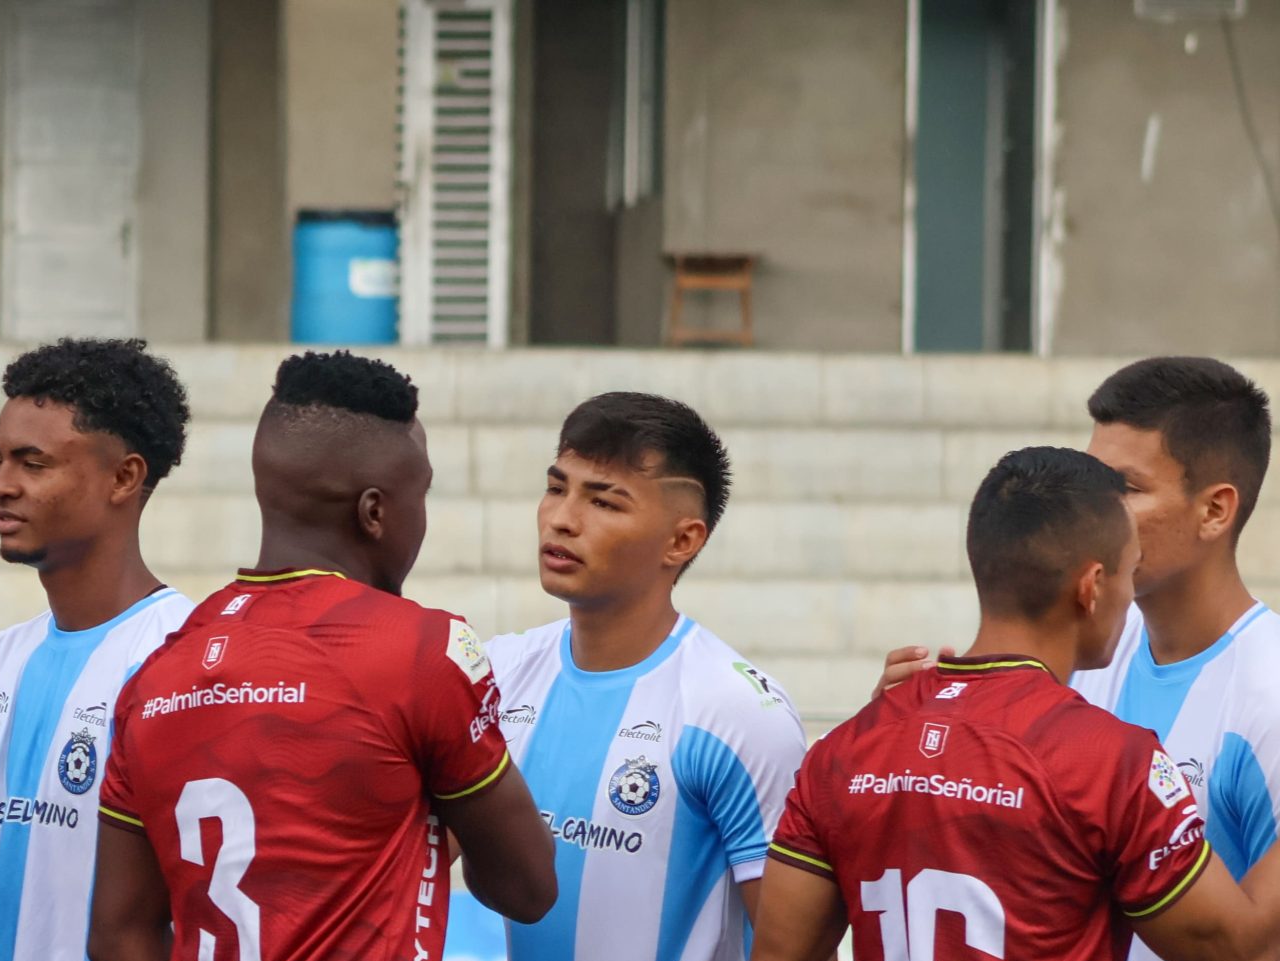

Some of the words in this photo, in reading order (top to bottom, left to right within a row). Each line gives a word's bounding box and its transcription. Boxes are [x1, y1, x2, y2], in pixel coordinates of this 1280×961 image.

[142, 681, 306, 719] #PalmiraSeñorial
[618, 728, 662, 743] Electrolit
[614, 797, 655, 815] SANTANDER
[563, 819, 643, 853] CAMINO
